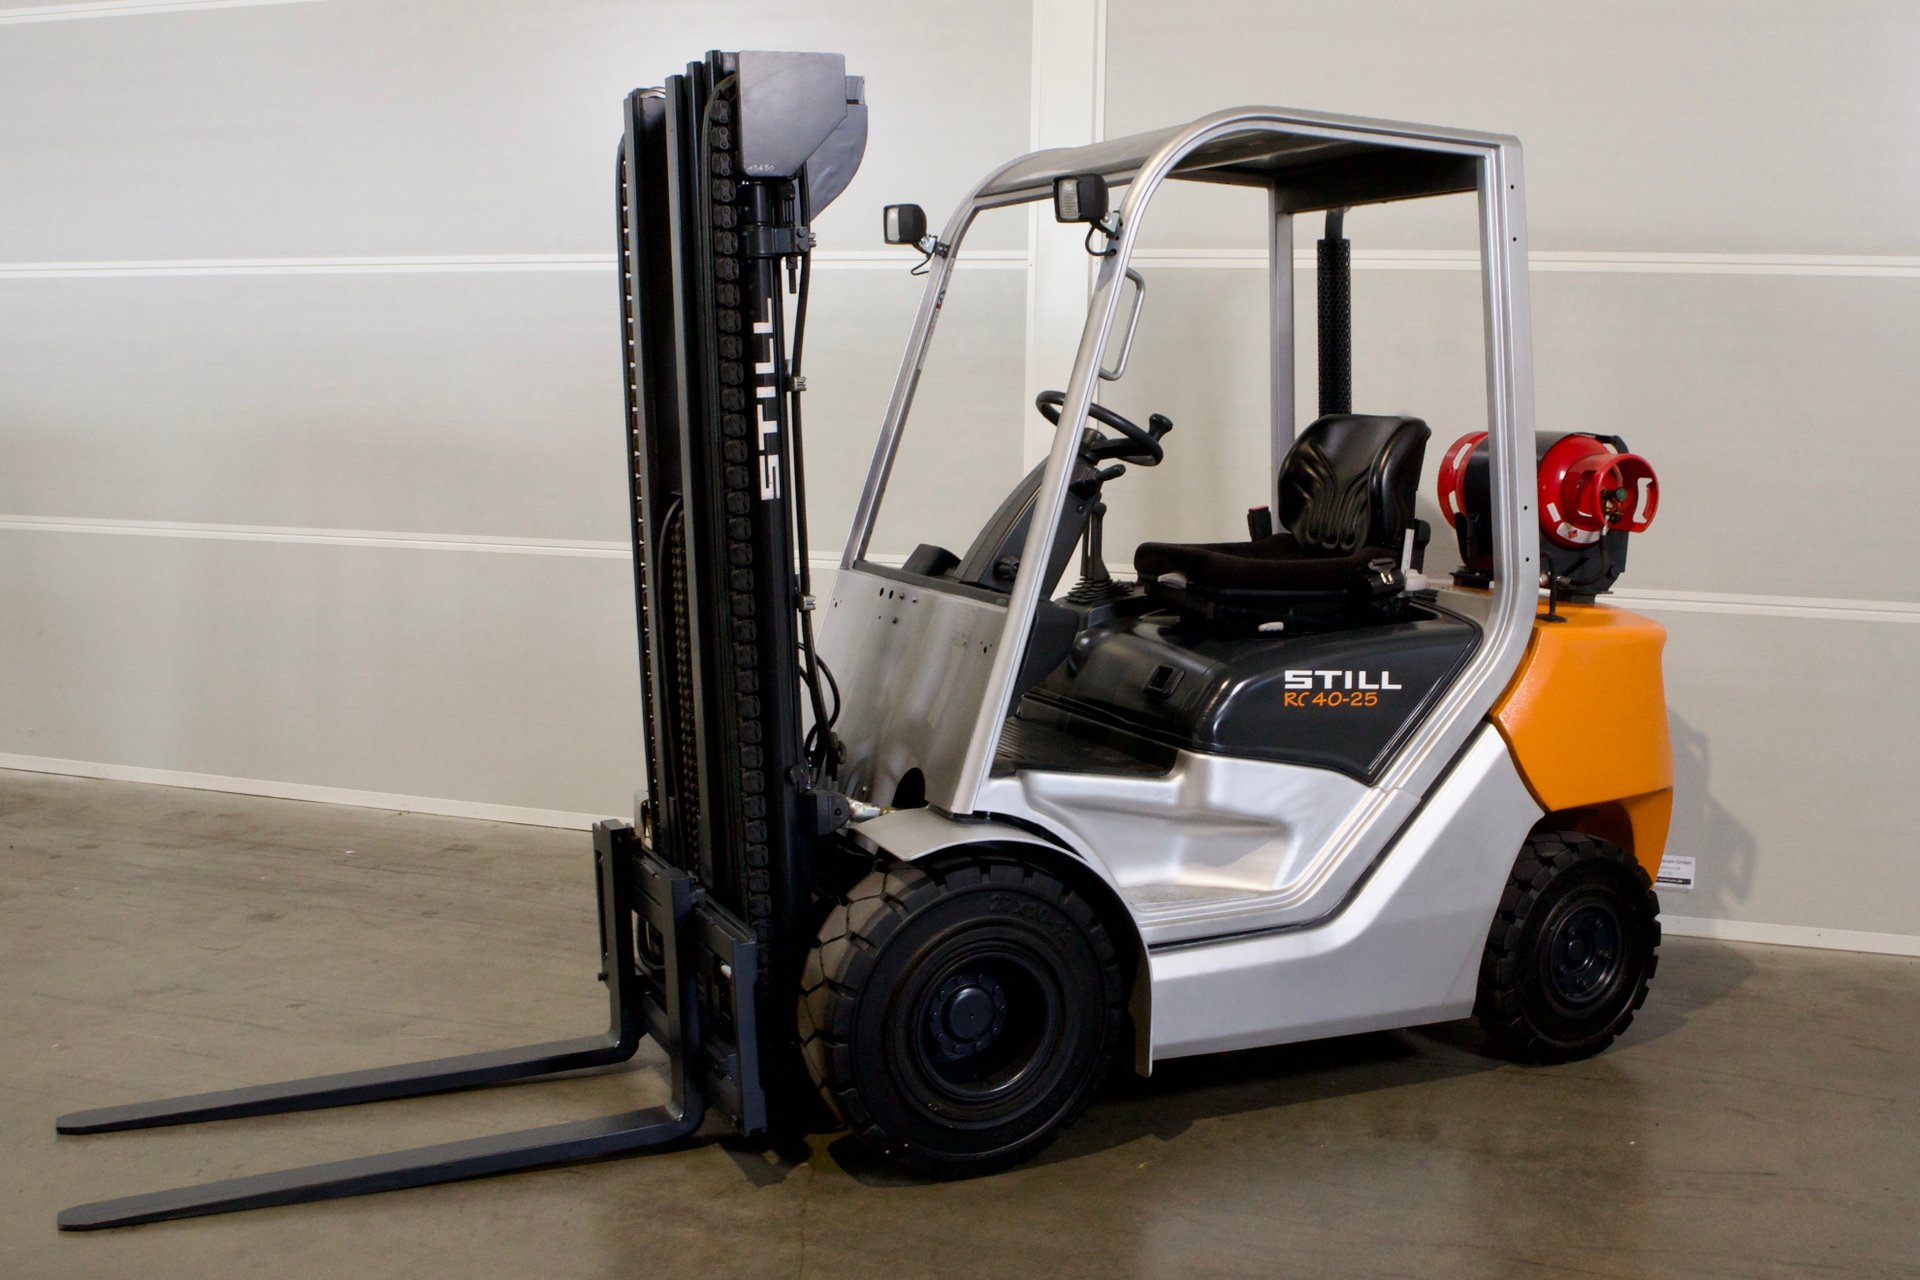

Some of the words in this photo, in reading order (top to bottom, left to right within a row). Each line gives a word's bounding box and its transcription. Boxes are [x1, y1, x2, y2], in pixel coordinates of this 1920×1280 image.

[753, 297, 781, 500] STILL
[1284, 669, 1403, 690] STILL
[1283, 691, 1310, 707] RC
[1311, 691, 1379, 707] 40-25
